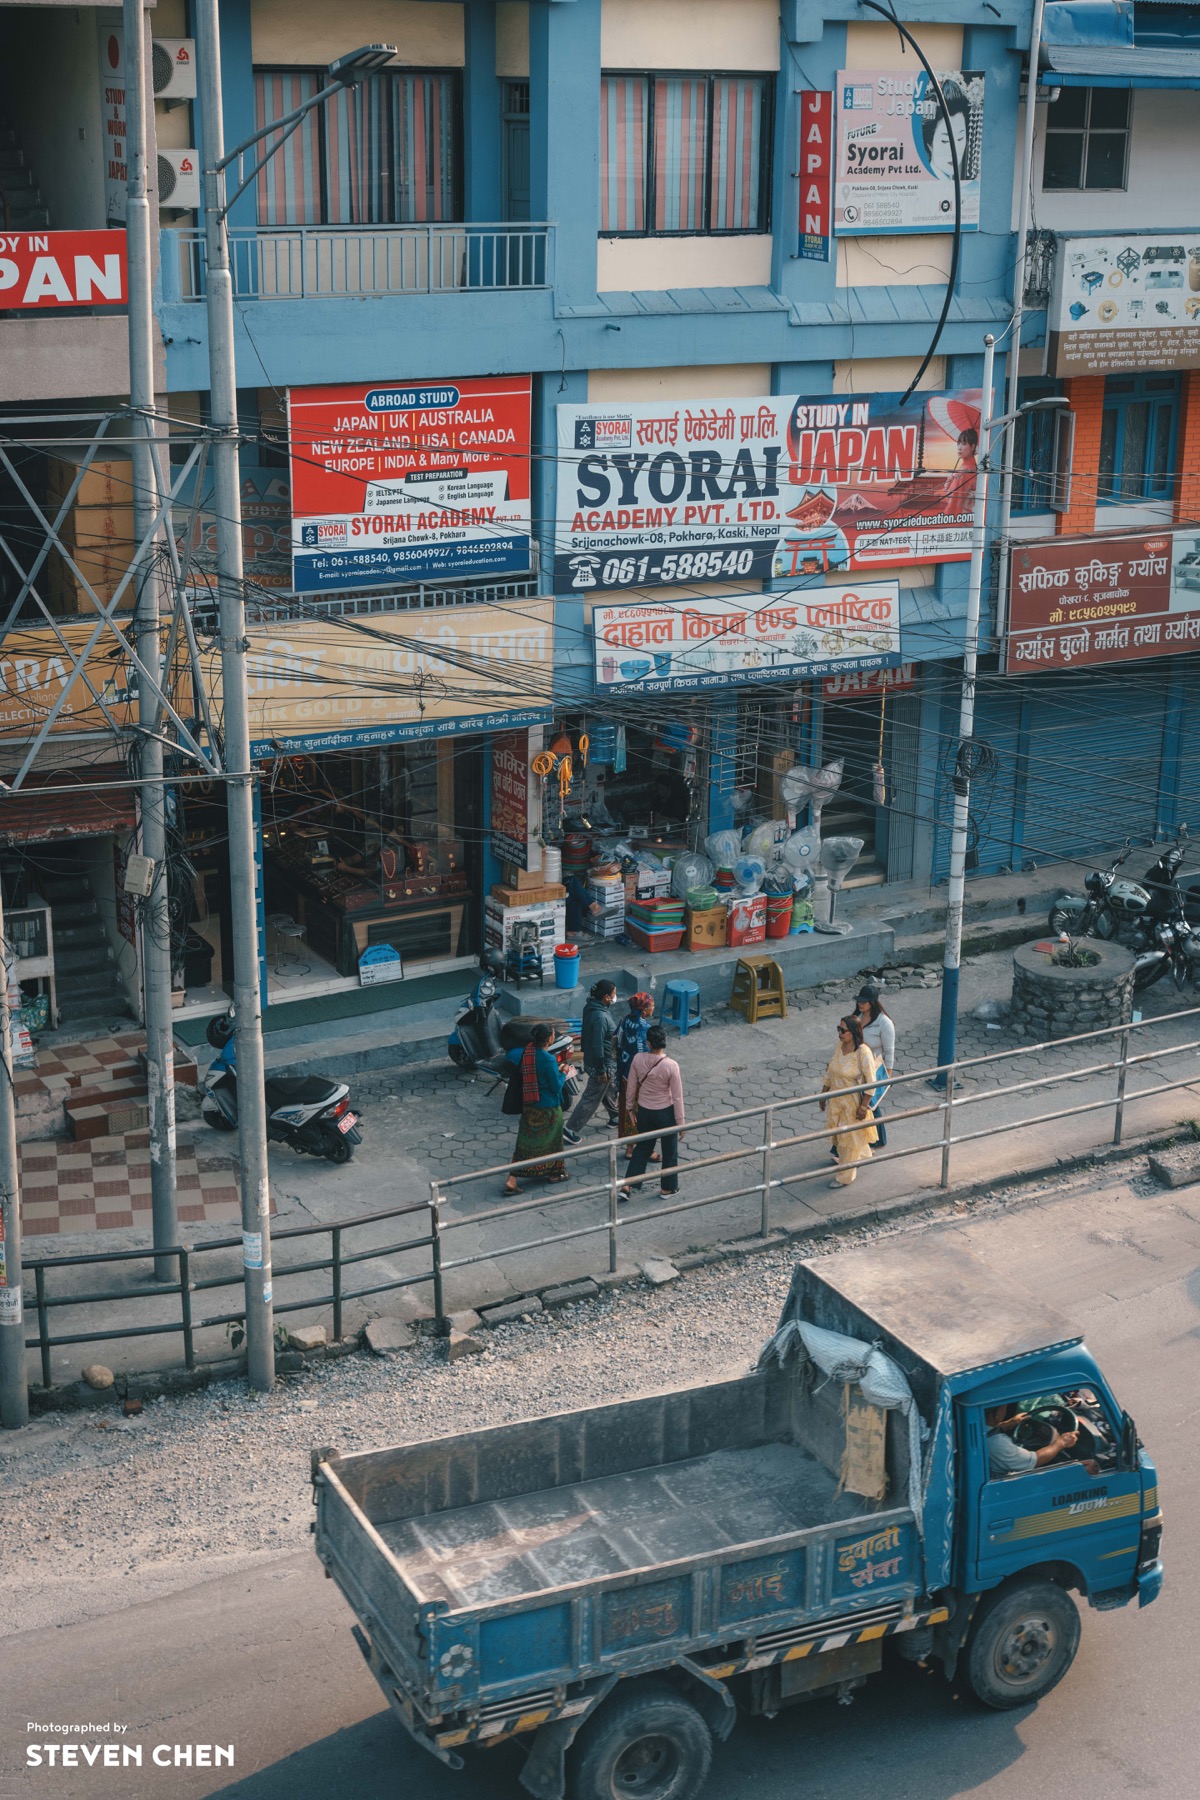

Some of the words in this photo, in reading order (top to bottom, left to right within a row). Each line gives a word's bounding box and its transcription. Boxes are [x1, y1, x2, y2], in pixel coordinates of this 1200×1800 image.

[105, 87, 126, 105] STUDY
[877, 76, 924, 98] Study
[113, 106, 119, 119] &
[886, 96, 937, 119] Japan
[847, 123, 877, 140] FUTURE
[113, 139, 122, 158] in
[847, 142, 904, 166] Syorai
[847, 166, 886, 176] Academy
[888, 165, 902, 174] Pvt
[905, 165, 921, 174] Ltd.
[28, 235, 49, 252] IN
[370, 393, 416, 407] ABROAD
[419, 391, 455, 405] STUDY
[333, 415, 378, 432] JAPAN
[389, 413, 409, 429] UK
[418, 408, 495, 427] AUSTRALIA
[796, 404, 850, 428] STUDY
[852, 403, 869, 426] IN
[595, 421, 630, 435] SYORAI
[636, 410, 680, 447] स्वराई
[684, 407, 736, 443] ऐकेडेमी
[311, 439, 343, 455] NEW
[346, 435, 411, 454] ZEALAND
[421, 432, 449, 448] USA
[459, 428, 516, 446] CANADA
[324, 457, 375, 473] EUROPE
[384, 454, 417, 469] INDIA
[418, 453, 427, 466] &
[430, 452, 460, 467] Many
[462, 451, 490, 463] More
[788, 425, 918, 486] JAPAN
[410, 472, 425, 481] TEST
[425, 470, 464, 480] PREPARATION
[447, 483, 466, 491] Korean
[467, 481, 494, 490] Language
[576, 446, 782, 508] SYORAI
[375, 498, 402, 506] Japanese
[447, 492, 467, 501] English
[467, 490, 494, 499] Language
[240, 505, 281, 516] TUDY
[351, 513, 411, 537] SYORAI
[417, 506, 497, 531] ACADEMY
[571, 506, 678, 533] ACADEMY
[684, 503, 730, 526] PVT.
[737, 500, 781, 522] LTD.
[318, 524, 347, 538] SYORAI
[382, 536, 406, 546] Srijana
[407, 532, 438, 544] Chowk-8,
[439, 530, 466, 540] Pokhara
[571, 532, 667, 550] Srijanachowk-08,
[669, 530, 716, 545] Pokhara,
[718, 526, 749, 540] Kaski,
[751, 524, 780, 538] Nepal
[312, 558, 329, 568] Tel:
[331, 553, 391, 567] 061-588540,
[393, 547, 454, 561] 9856049927,
[456, 541, 513, 555] 9846502894
[432, 561, 447, 569] Web:
[602, 548, 754, 585] 061-588540
[1018, 565, 1071, 593] सफिक
[1128, 552, 1168, 578] ग्याँस
[603, 618, 675, 649] दाहाल
[681, 607, 748, 641] किचन
[755, 606, 799, 634] एण्ड
[806, 592, 893, 628] प्लाष्टिक
[1016, 633, 1056, 661] ग्याँस
[1094, 623, 1131, 650] मर्मत
[1134, 623, 1162, 647] तथा
[646, 677, 672, 692] सम्पूर्ण
[673, 677, 699, 689] किचन
[294, 696, 362, 718] GOLD
[492, 748, 528, 780] समिर
[1052, 1485, 1108, 1507] LOADKING
[850, 1556, 904, 1588] सेवा
